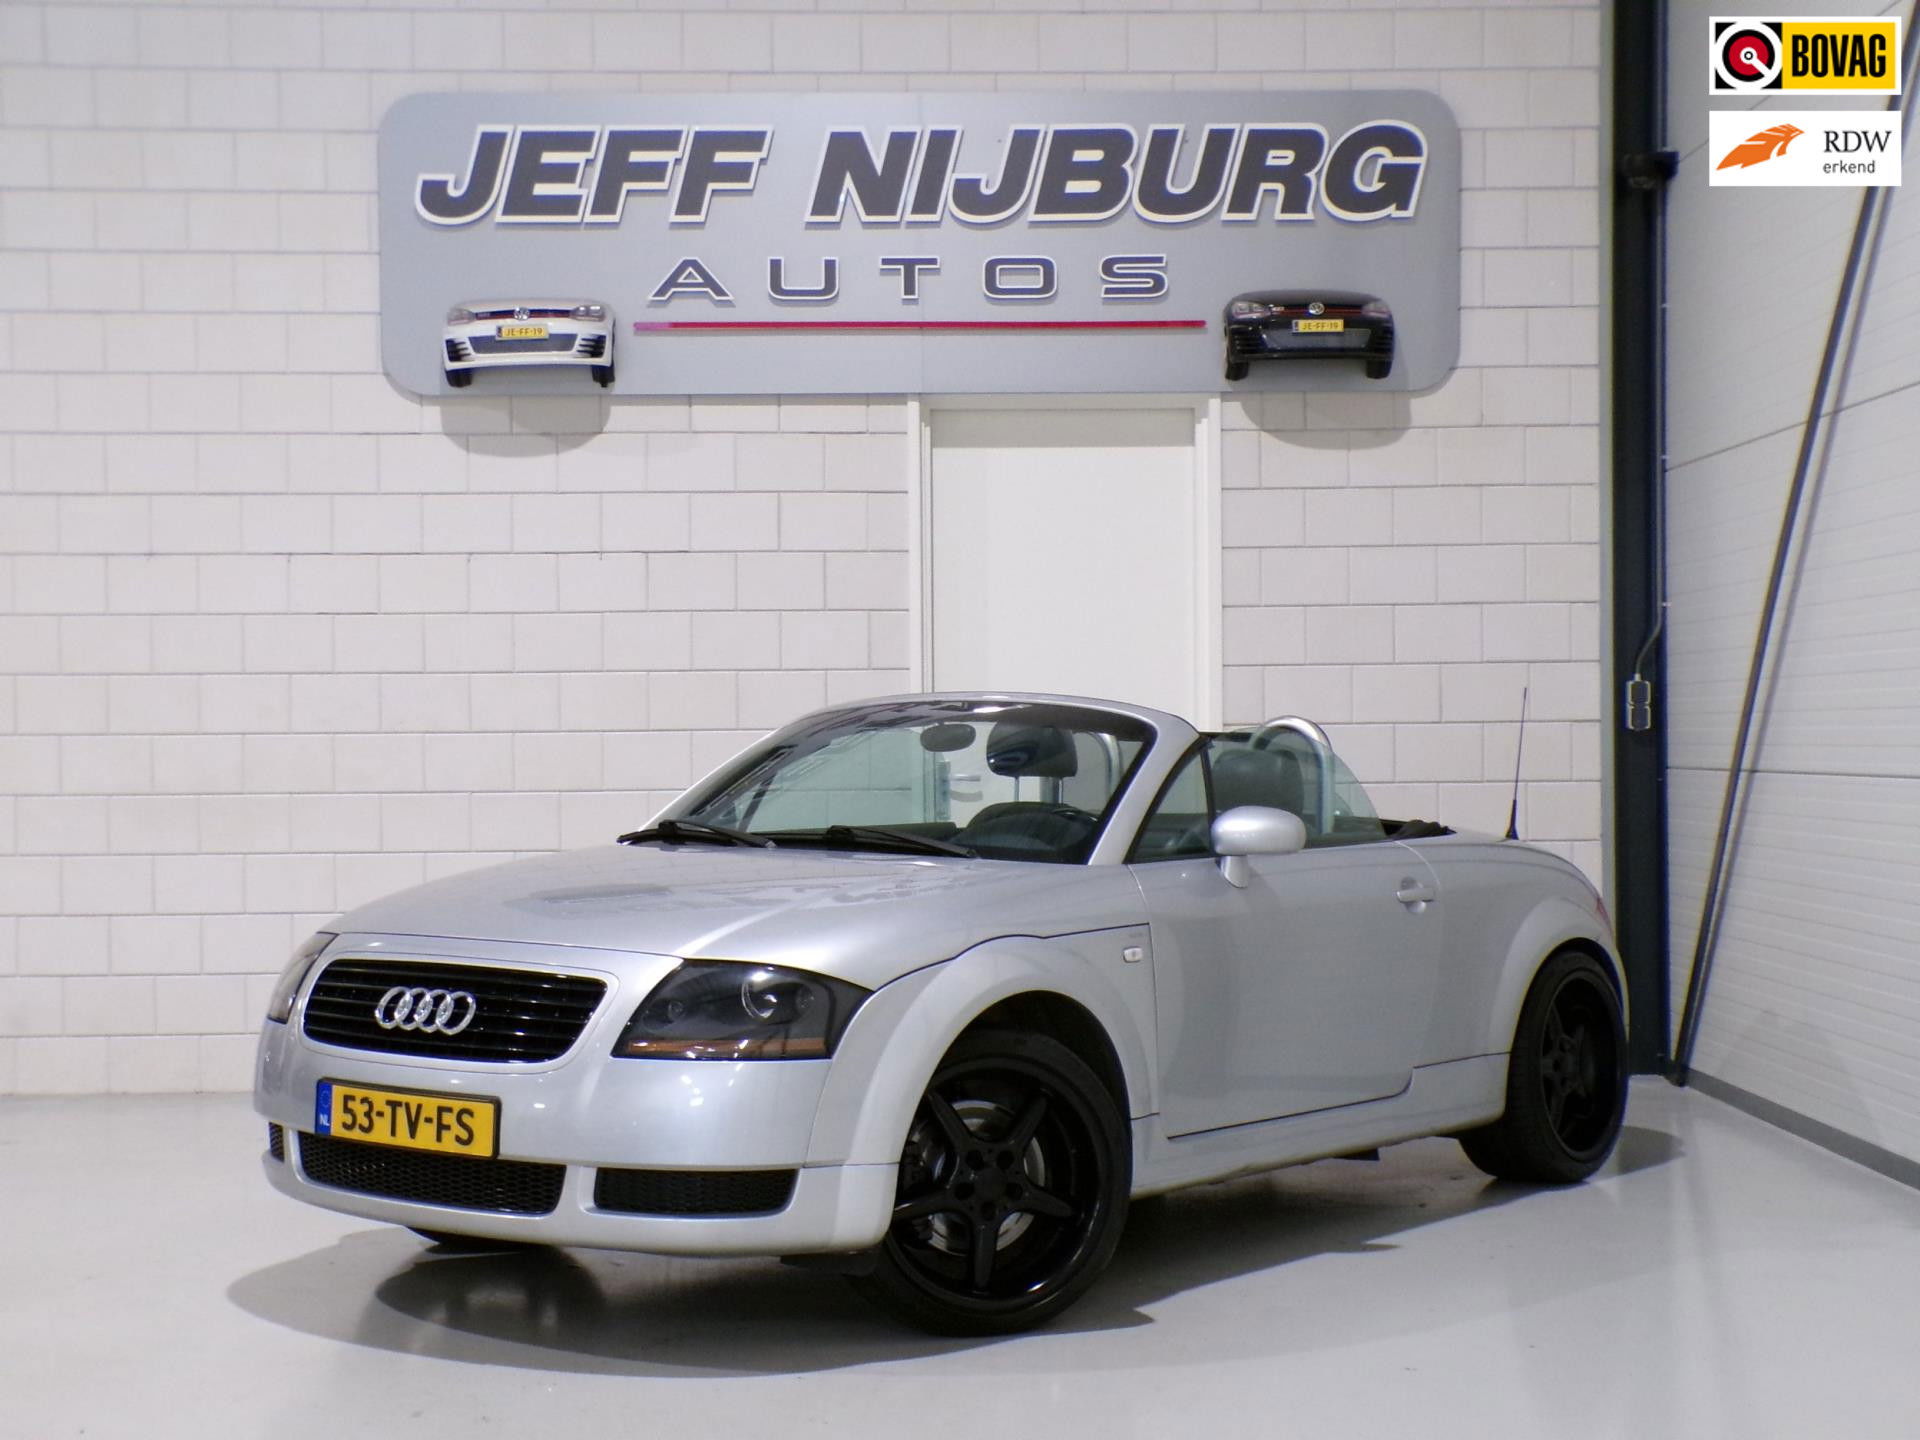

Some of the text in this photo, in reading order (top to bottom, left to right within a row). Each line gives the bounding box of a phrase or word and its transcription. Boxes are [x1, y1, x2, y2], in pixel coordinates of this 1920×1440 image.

[415, 119, 1428, 225] JEFF NIJBURG
[647, 253, 1169, 301] AUTOS
[504, 327, 544, 337] JE-FF-19
[319, 1113, 330, 1127] NL
[342, 1094, 475, 1146] 53-TV-FS
